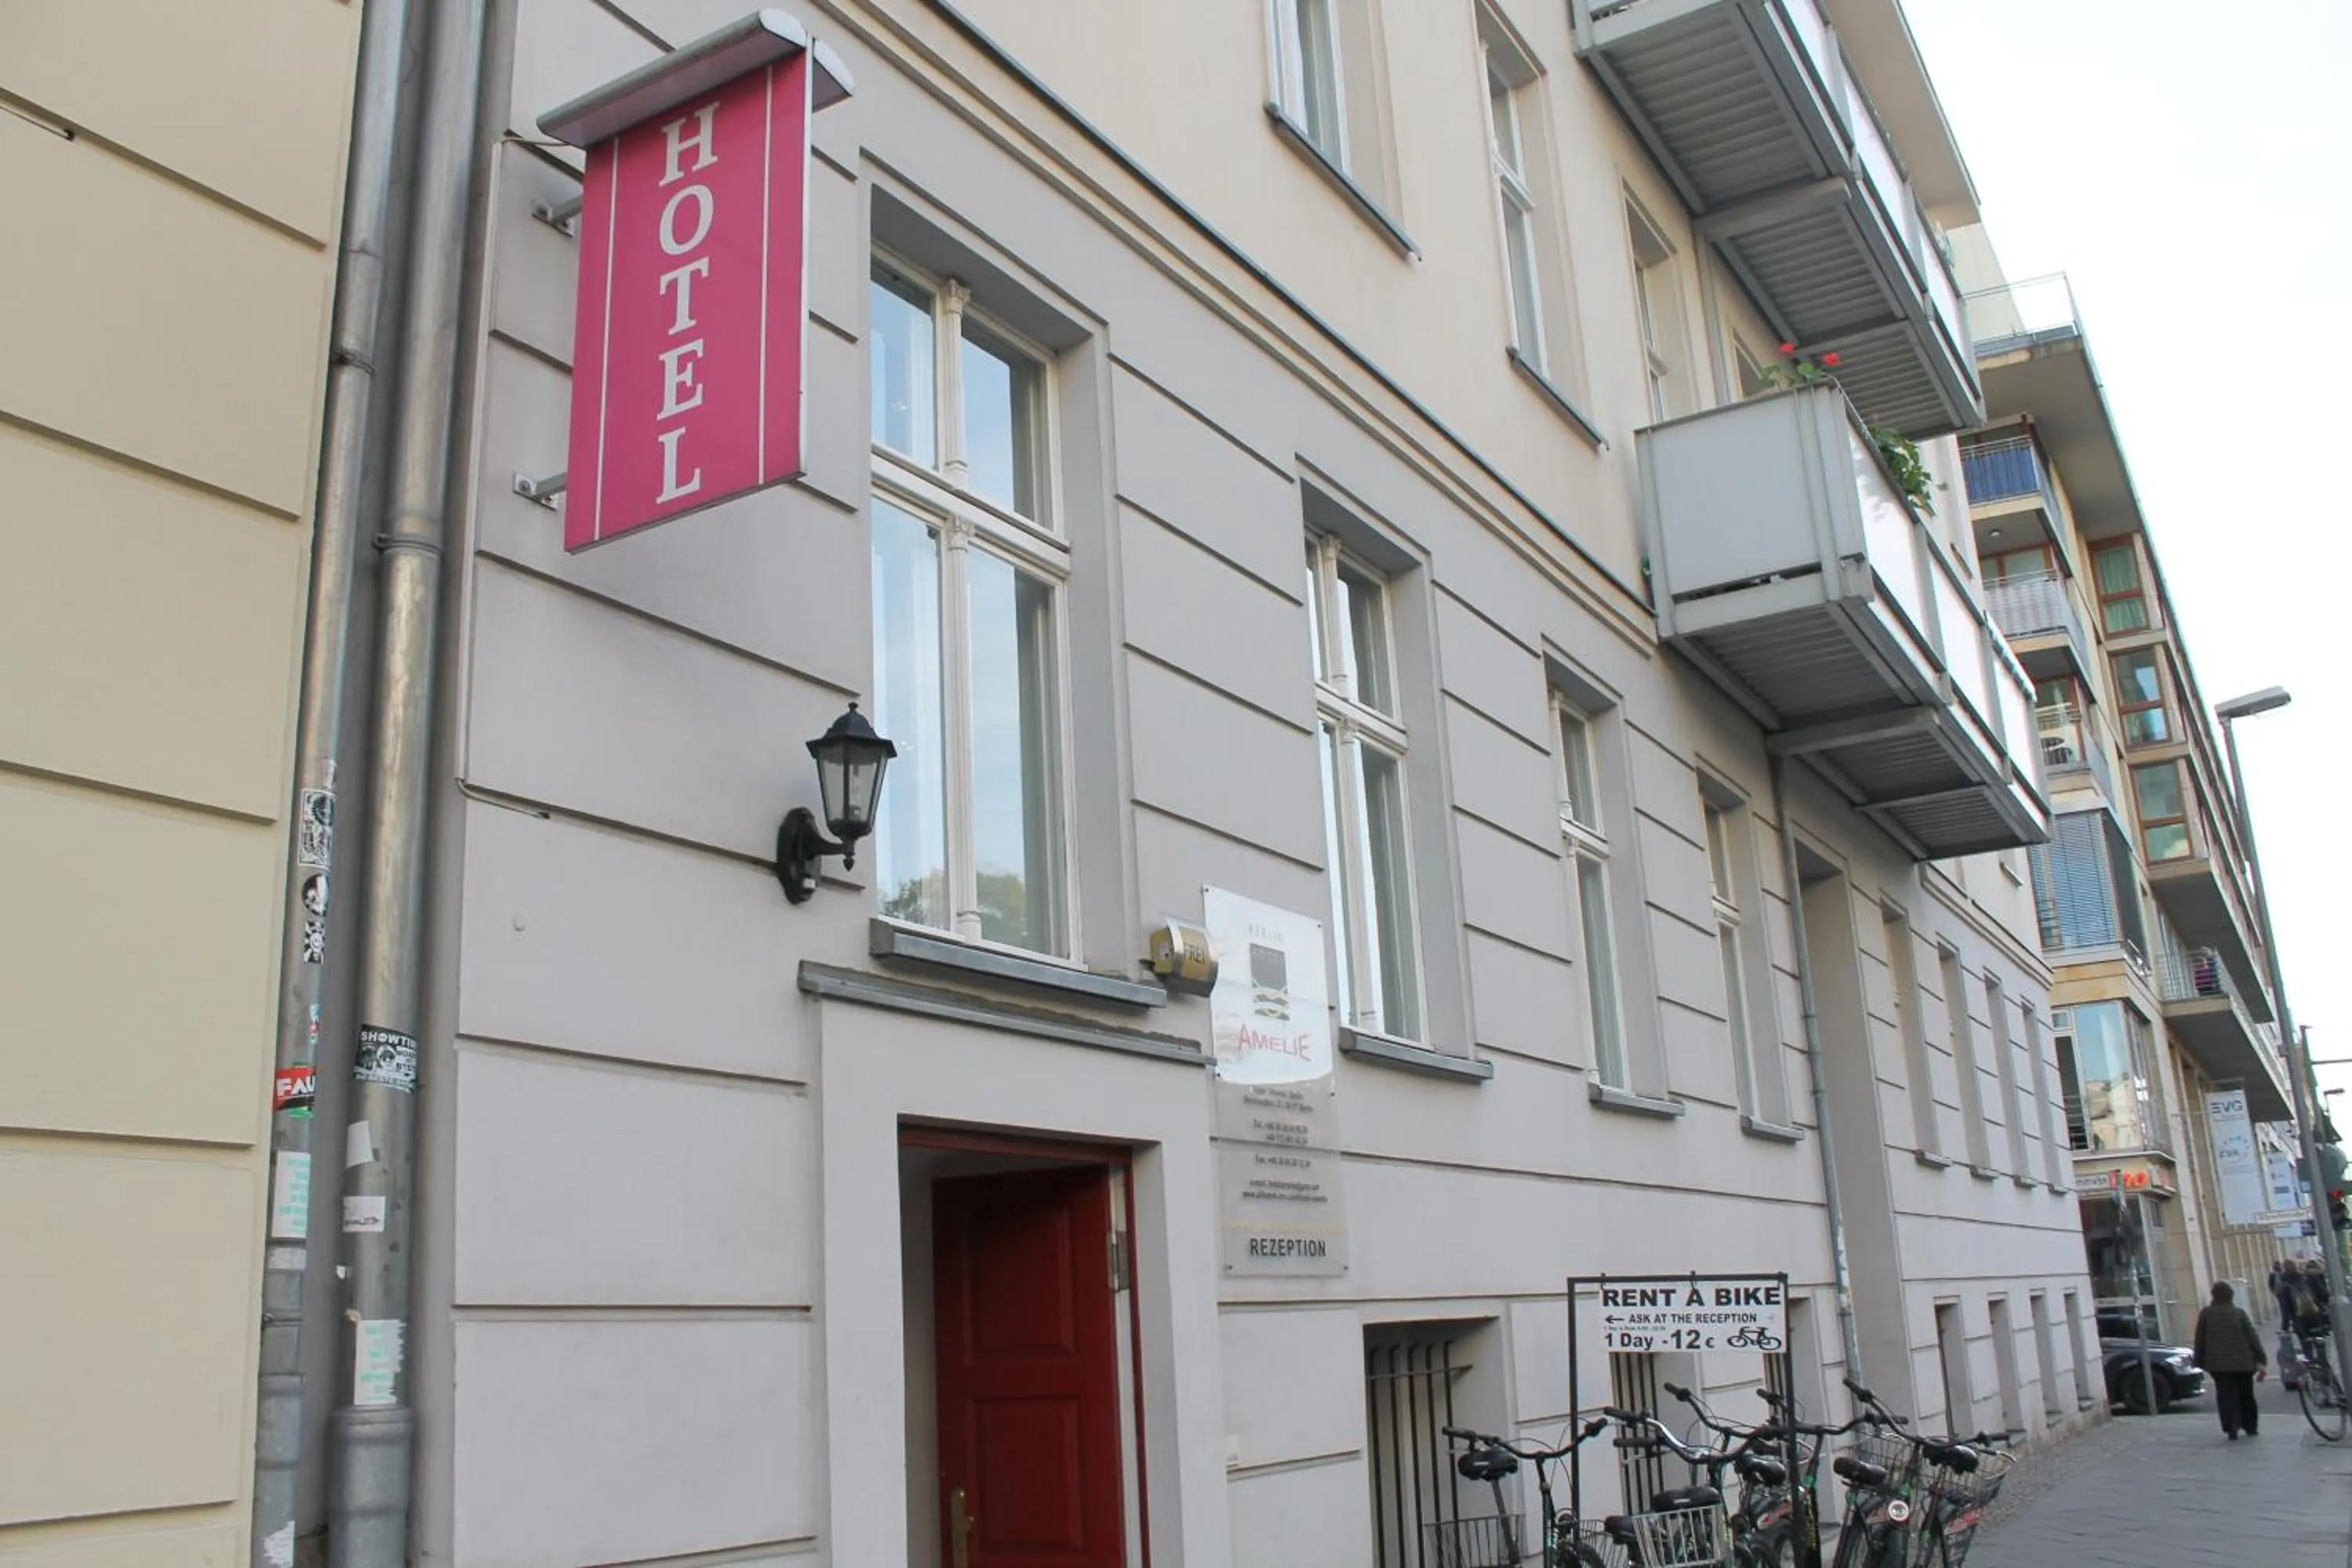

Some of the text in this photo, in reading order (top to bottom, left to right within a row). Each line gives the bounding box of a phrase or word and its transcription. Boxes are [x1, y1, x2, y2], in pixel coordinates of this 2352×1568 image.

[655, 102, 720, 504] HOTEL
[1238, 1022, 1312, 1062] AMELIE
[1250, 1237, 1326, 1257] REZEPTION
[1602, 1287, 1781, 1307] RENT A BIKE
[1628, 1313, 1757, 1324] ASK AT THE RECEPTION
[1606, 1333, 1613, 1347] 1
[1621, 1332, 1653, 1351] Day
